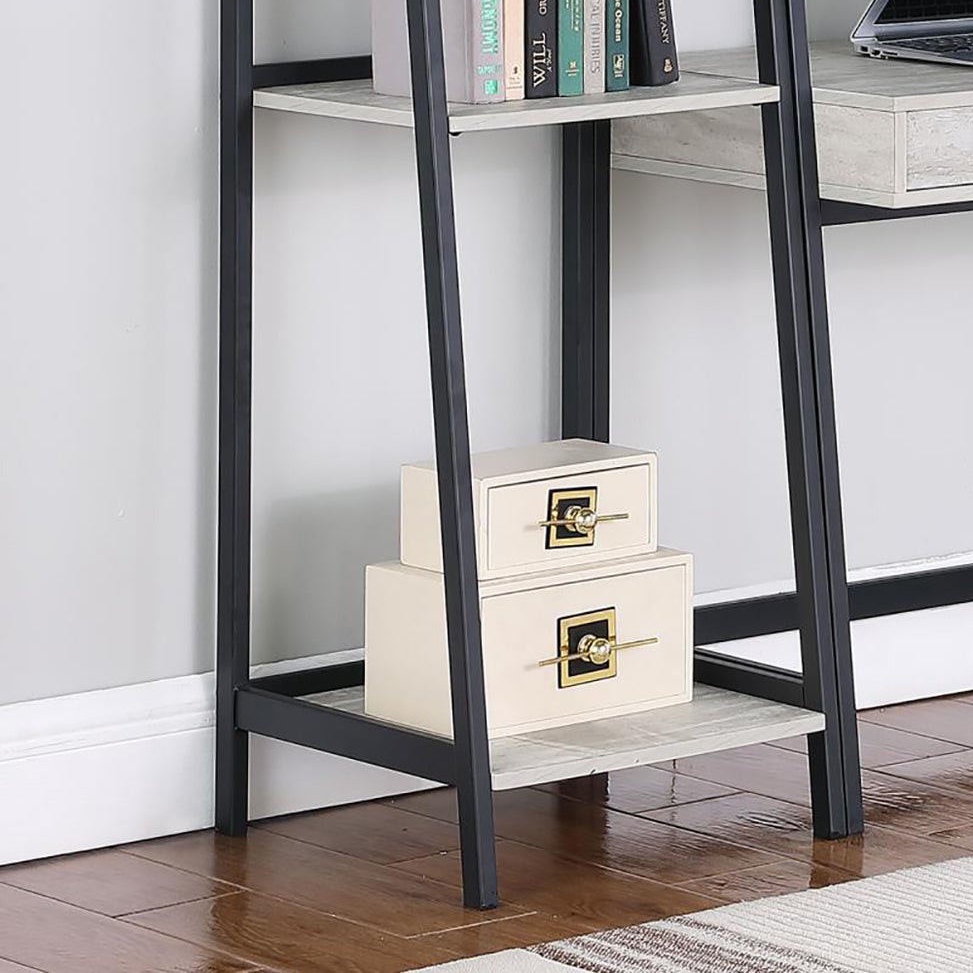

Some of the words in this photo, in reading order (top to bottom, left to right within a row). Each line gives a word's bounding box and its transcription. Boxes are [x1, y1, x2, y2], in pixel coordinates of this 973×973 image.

[614, 9, 623, 42] Ocean
[657, 0, 670, 45] TIFFANY
[533, 32, 546, 88] WILL
